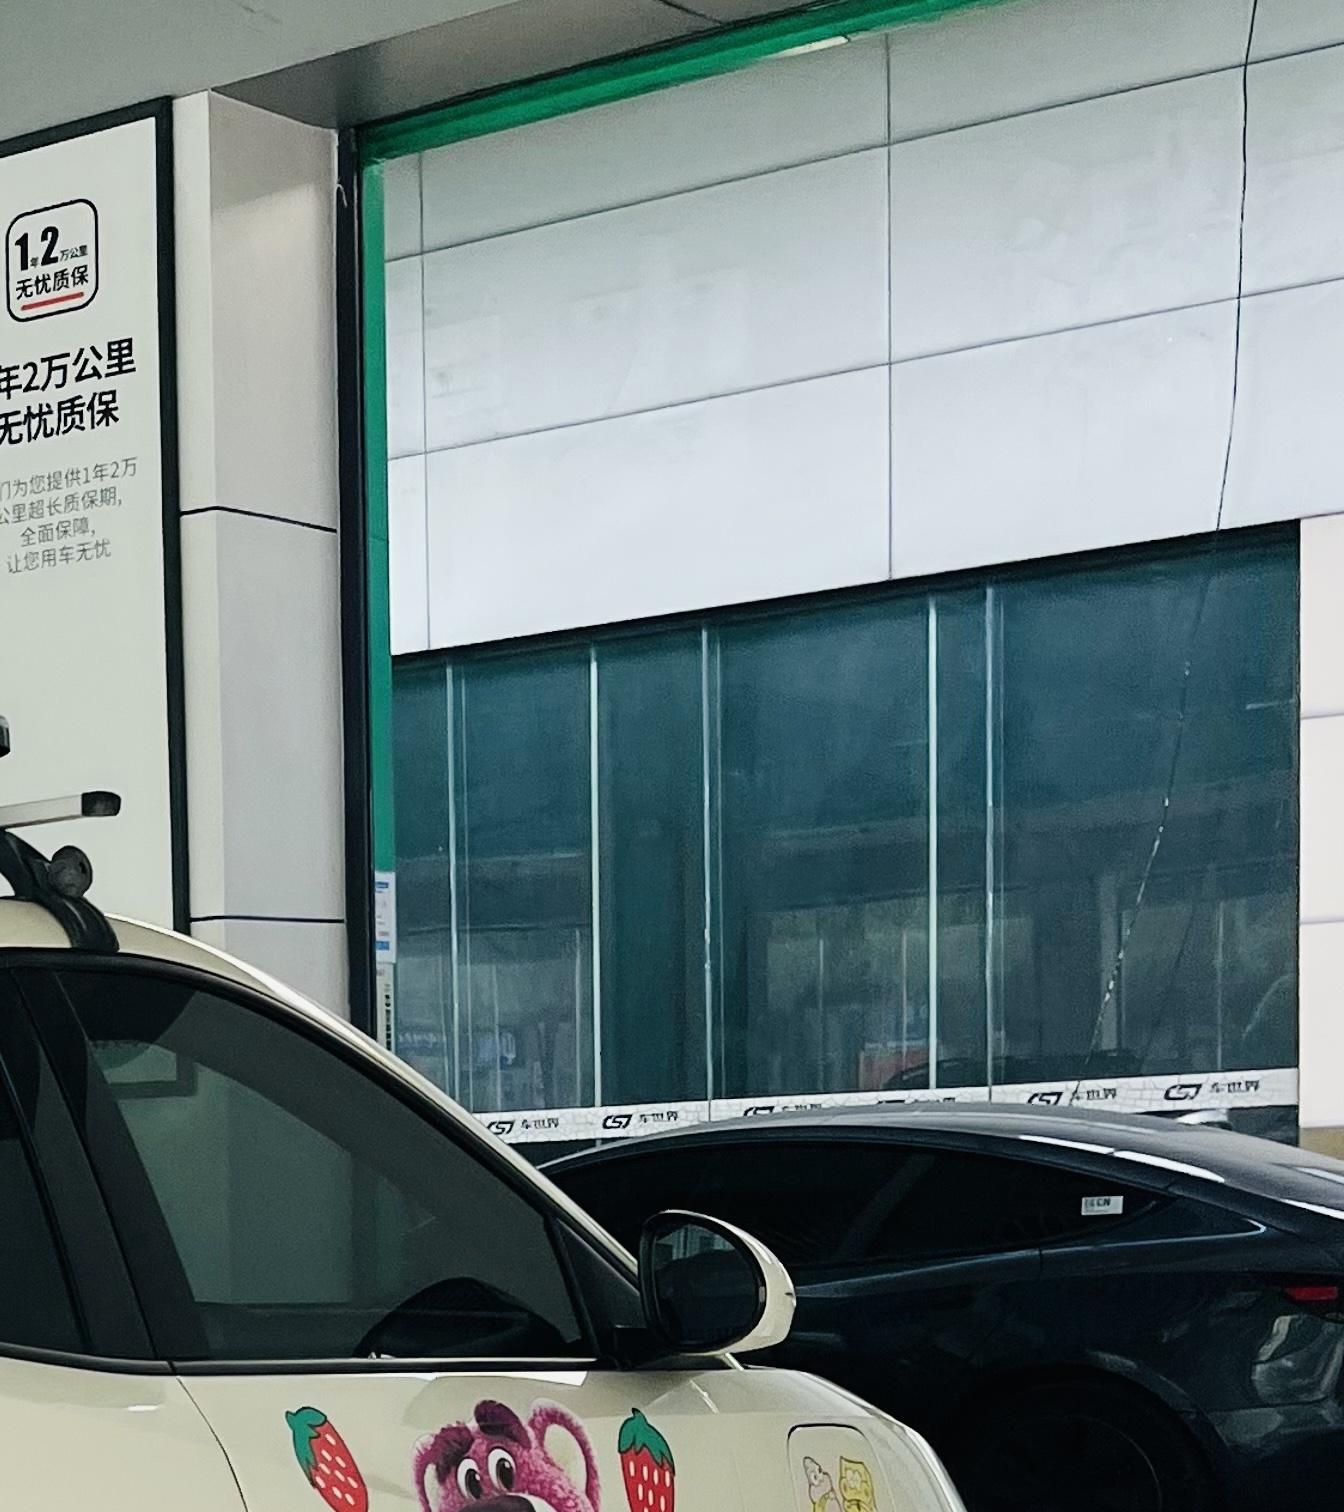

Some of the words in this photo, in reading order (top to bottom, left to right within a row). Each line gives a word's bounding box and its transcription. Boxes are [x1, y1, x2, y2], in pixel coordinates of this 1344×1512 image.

[16, 264, 89, 300] 无忧质保
[6, 539, 111, 574] 让您用车无忧
